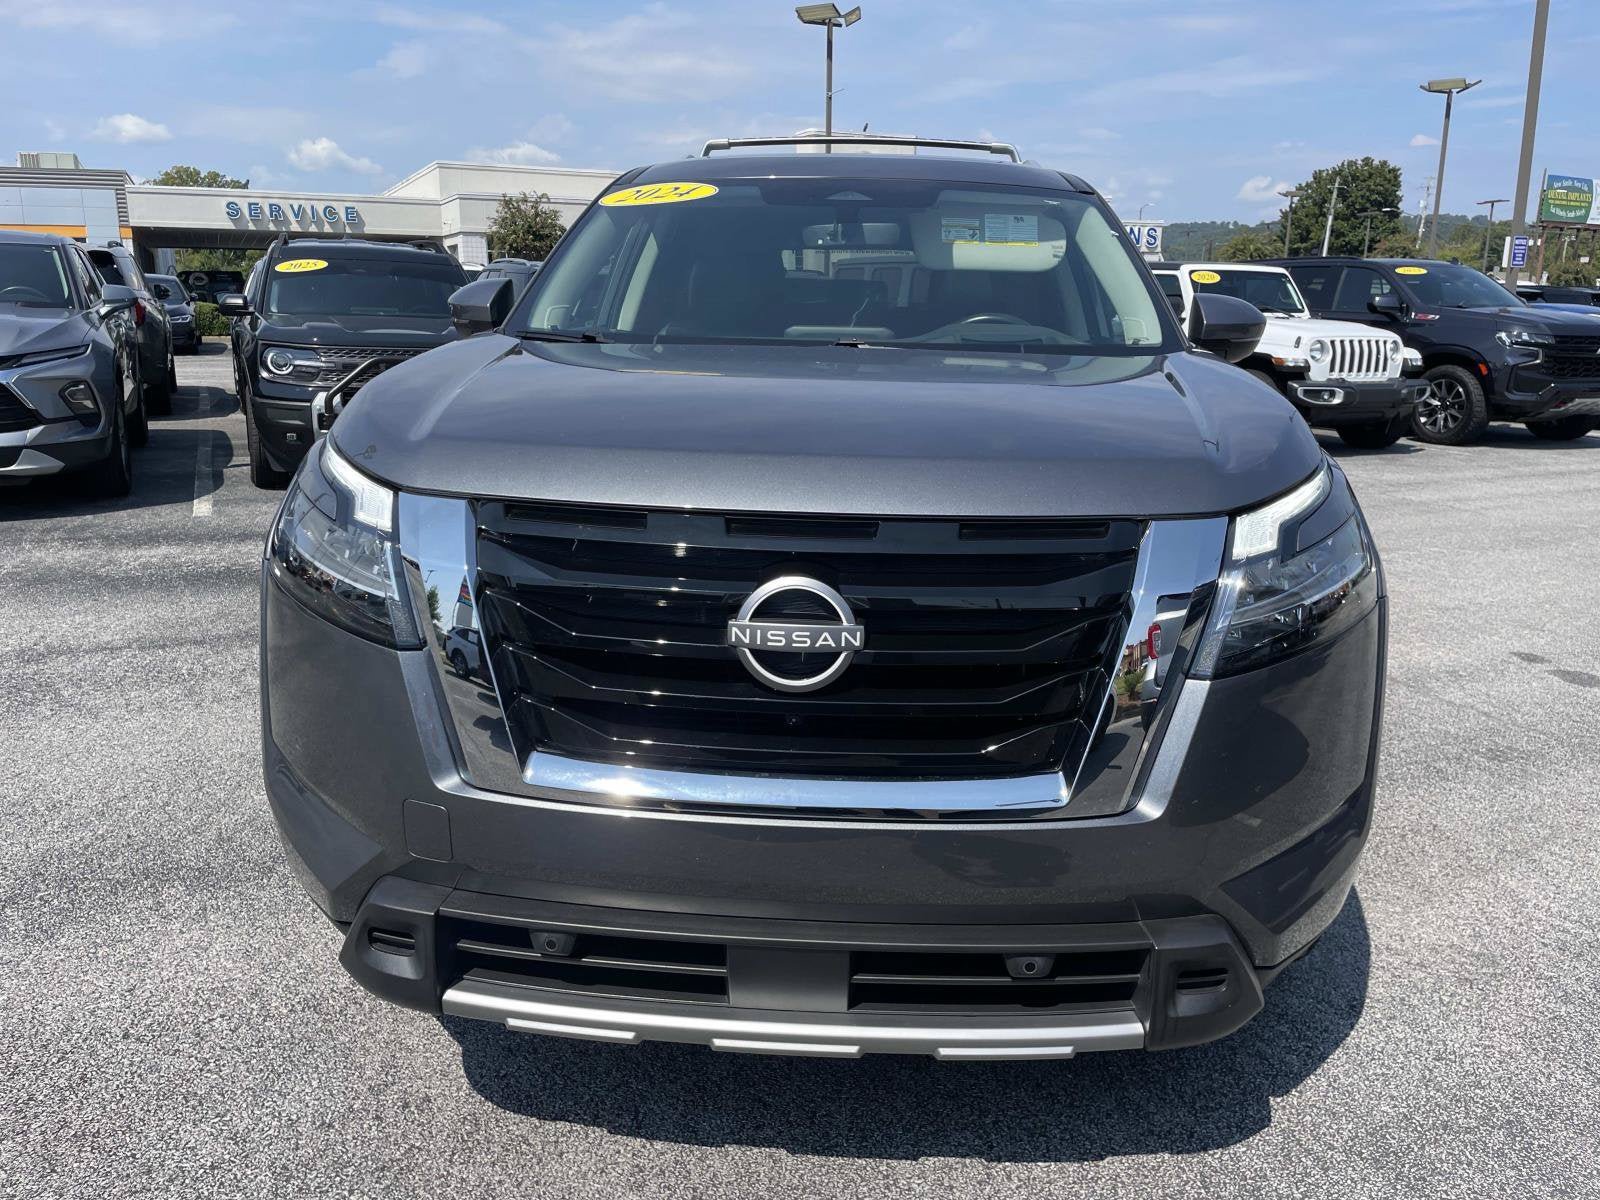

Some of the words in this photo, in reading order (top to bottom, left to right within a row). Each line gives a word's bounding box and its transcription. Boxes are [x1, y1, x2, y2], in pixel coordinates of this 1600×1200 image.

[614, 185, 707, 203] 2024
[1548, 190, 1567, 199] DENTAL
[1567, 191, 1592, 202] IMPLANTS
[225, 201, 358, 223] SERVICE
[731, 626, 861, 647] NISSAN
